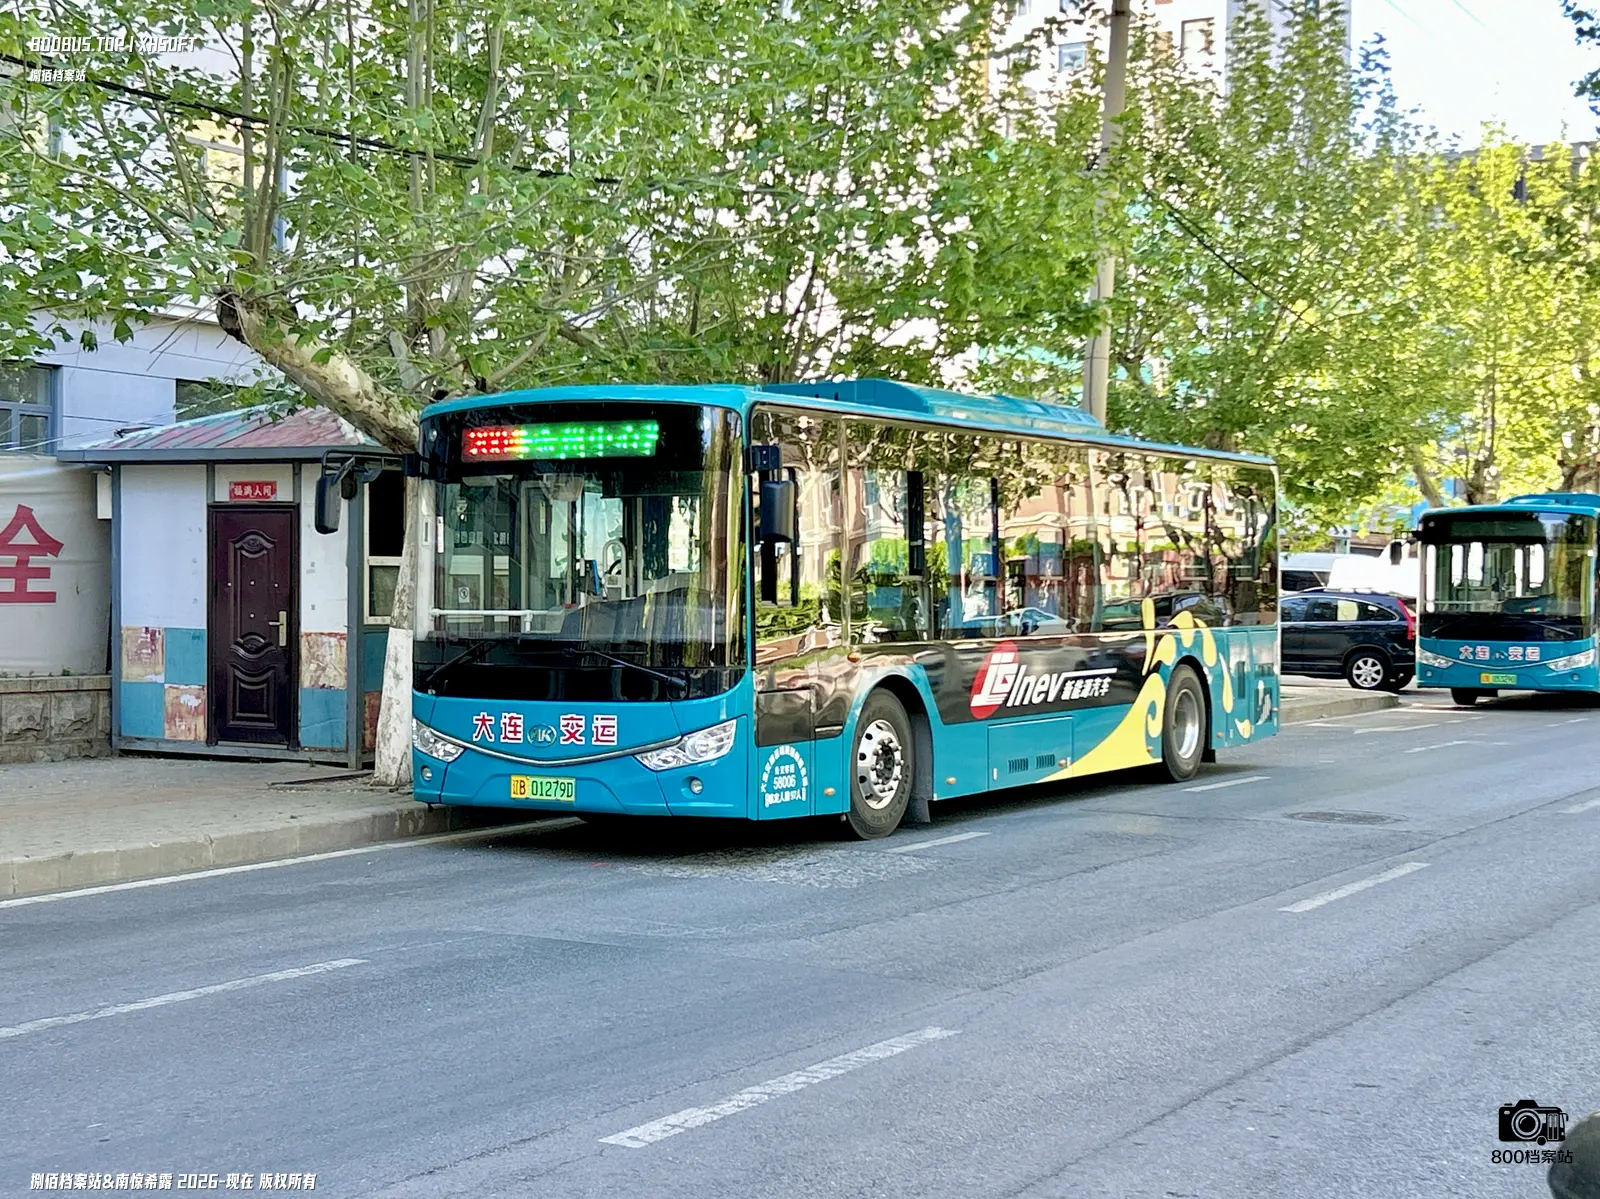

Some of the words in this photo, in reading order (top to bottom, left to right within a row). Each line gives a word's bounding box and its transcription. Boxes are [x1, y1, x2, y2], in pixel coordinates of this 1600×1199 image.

[0, 504, 64, 603] 全
[473, 712, 523, 743] 大连
[560, 714, 617, 745] 交运
[531, 780, 573, 798] 01279D
